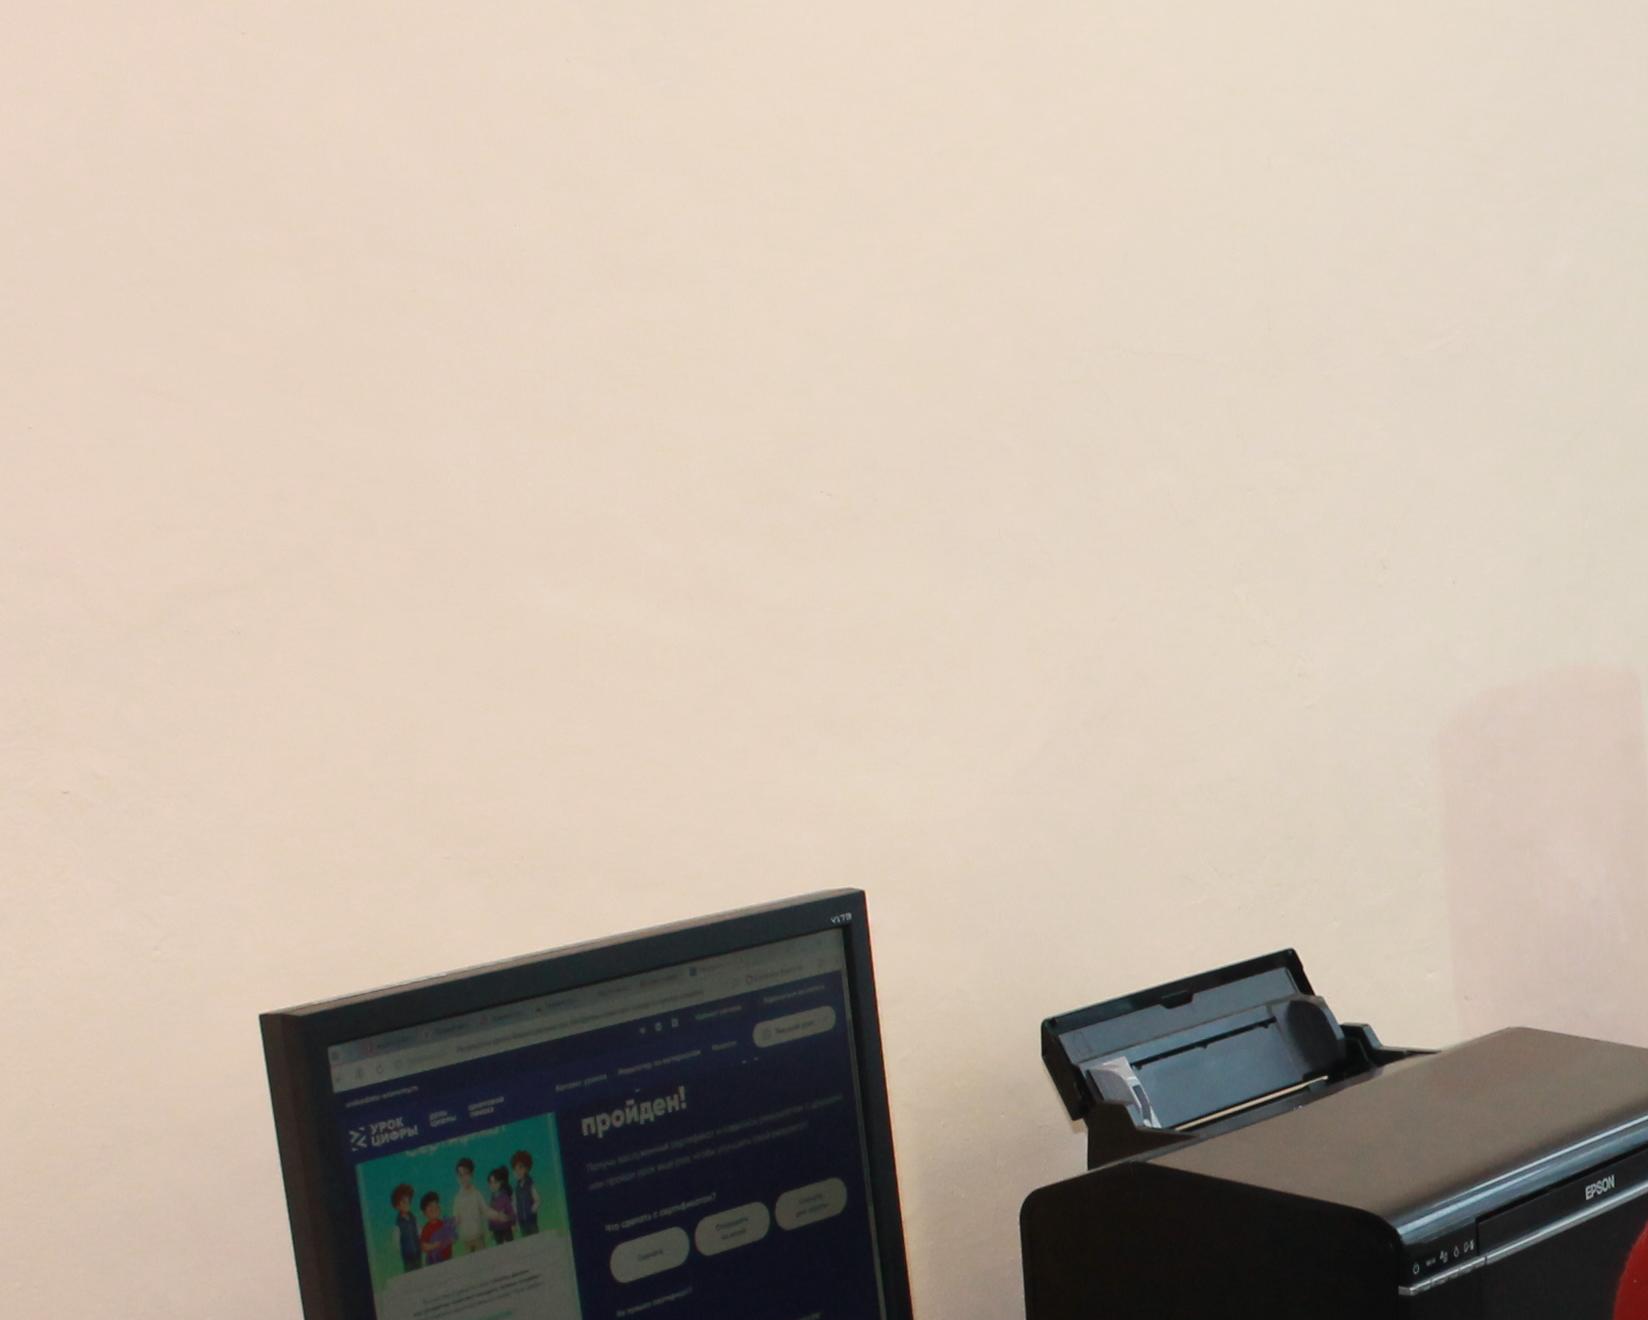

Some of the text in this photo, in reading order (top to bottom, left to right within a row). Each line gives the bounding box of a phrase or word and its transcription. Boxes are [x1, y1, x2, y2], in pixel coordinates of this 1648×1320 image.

[369, 1116, 404, 1135] УРОК
[580, 1085, 688, 1141] пройден!
[370, 1124, 419, 1148] ЦИФРЫ
[1585, 1174, 1615, 1201] EPSON
